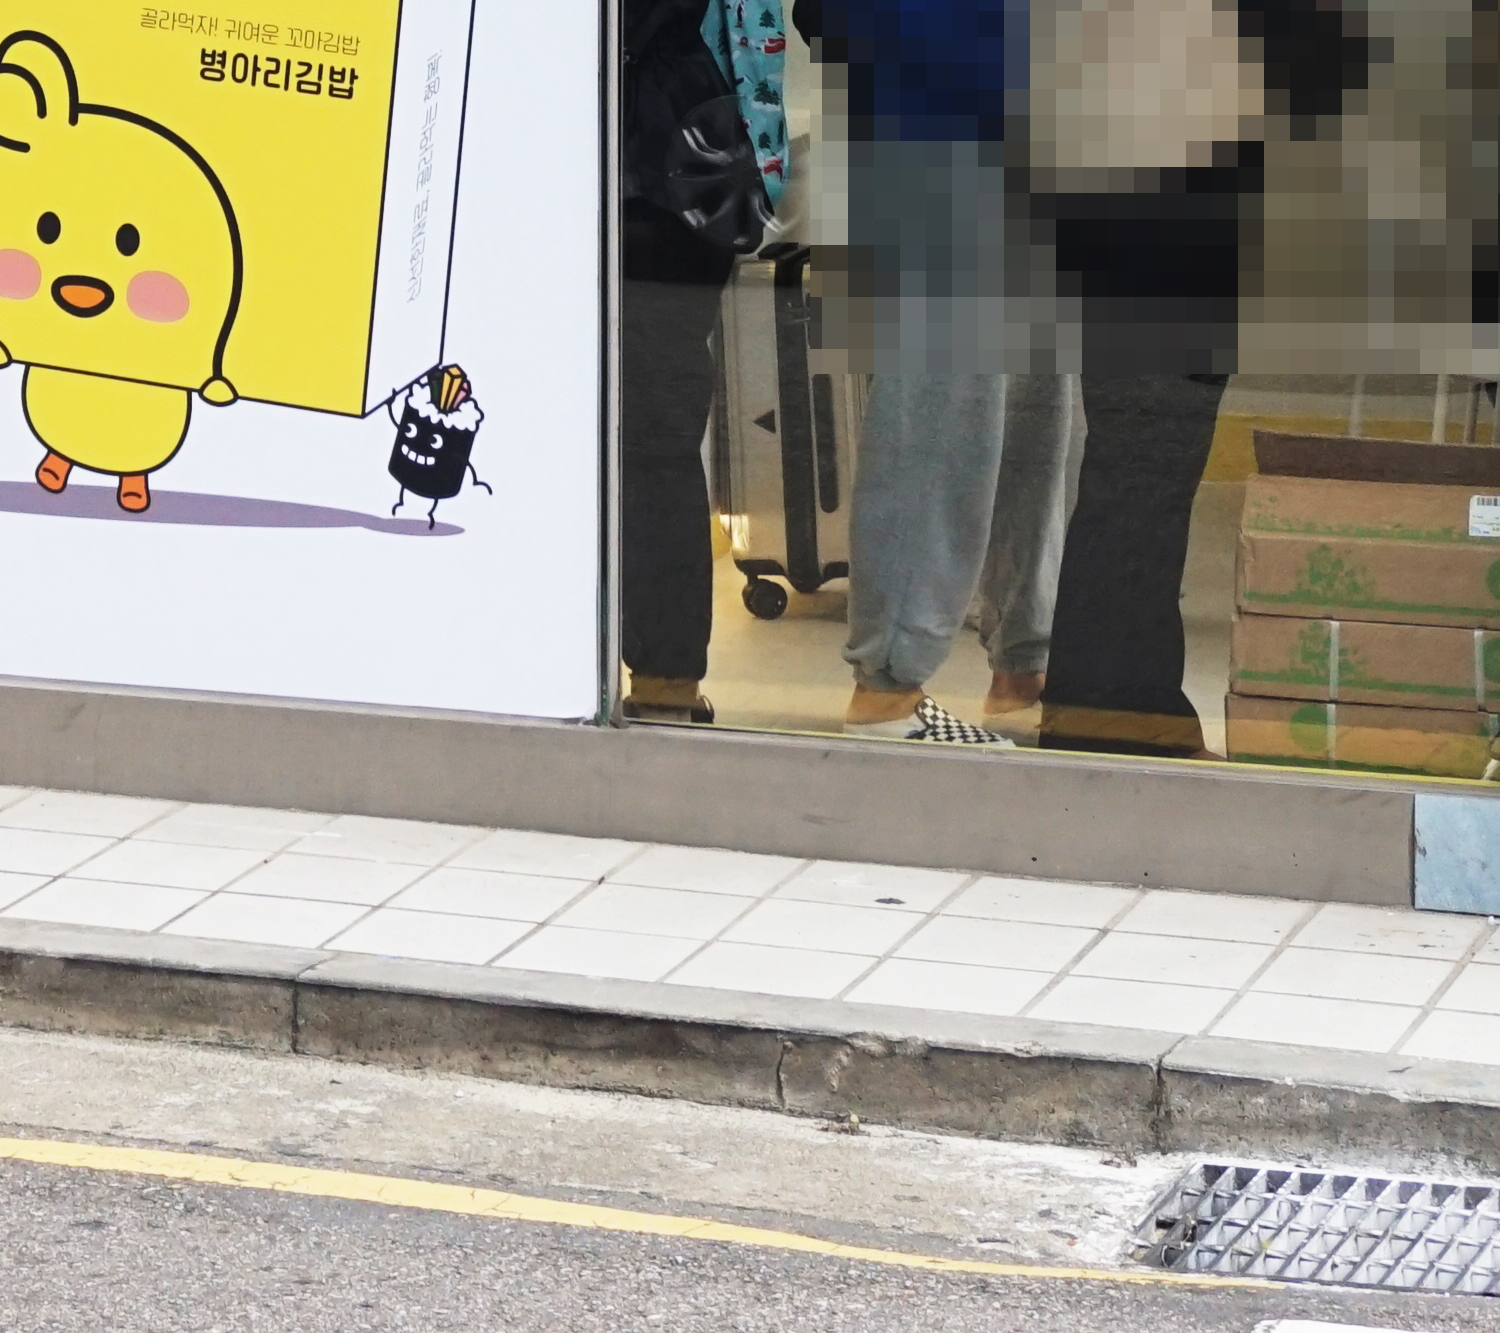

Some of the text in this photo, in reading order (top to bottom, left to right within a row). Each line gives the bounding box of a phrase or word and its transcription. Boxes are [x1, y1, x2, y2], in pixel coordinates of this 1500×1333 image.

[139, 6, 362, 57] 골라먹자! 귀여운 꼬마김밥
[198, 46, 360, 101] 병아리김밥
